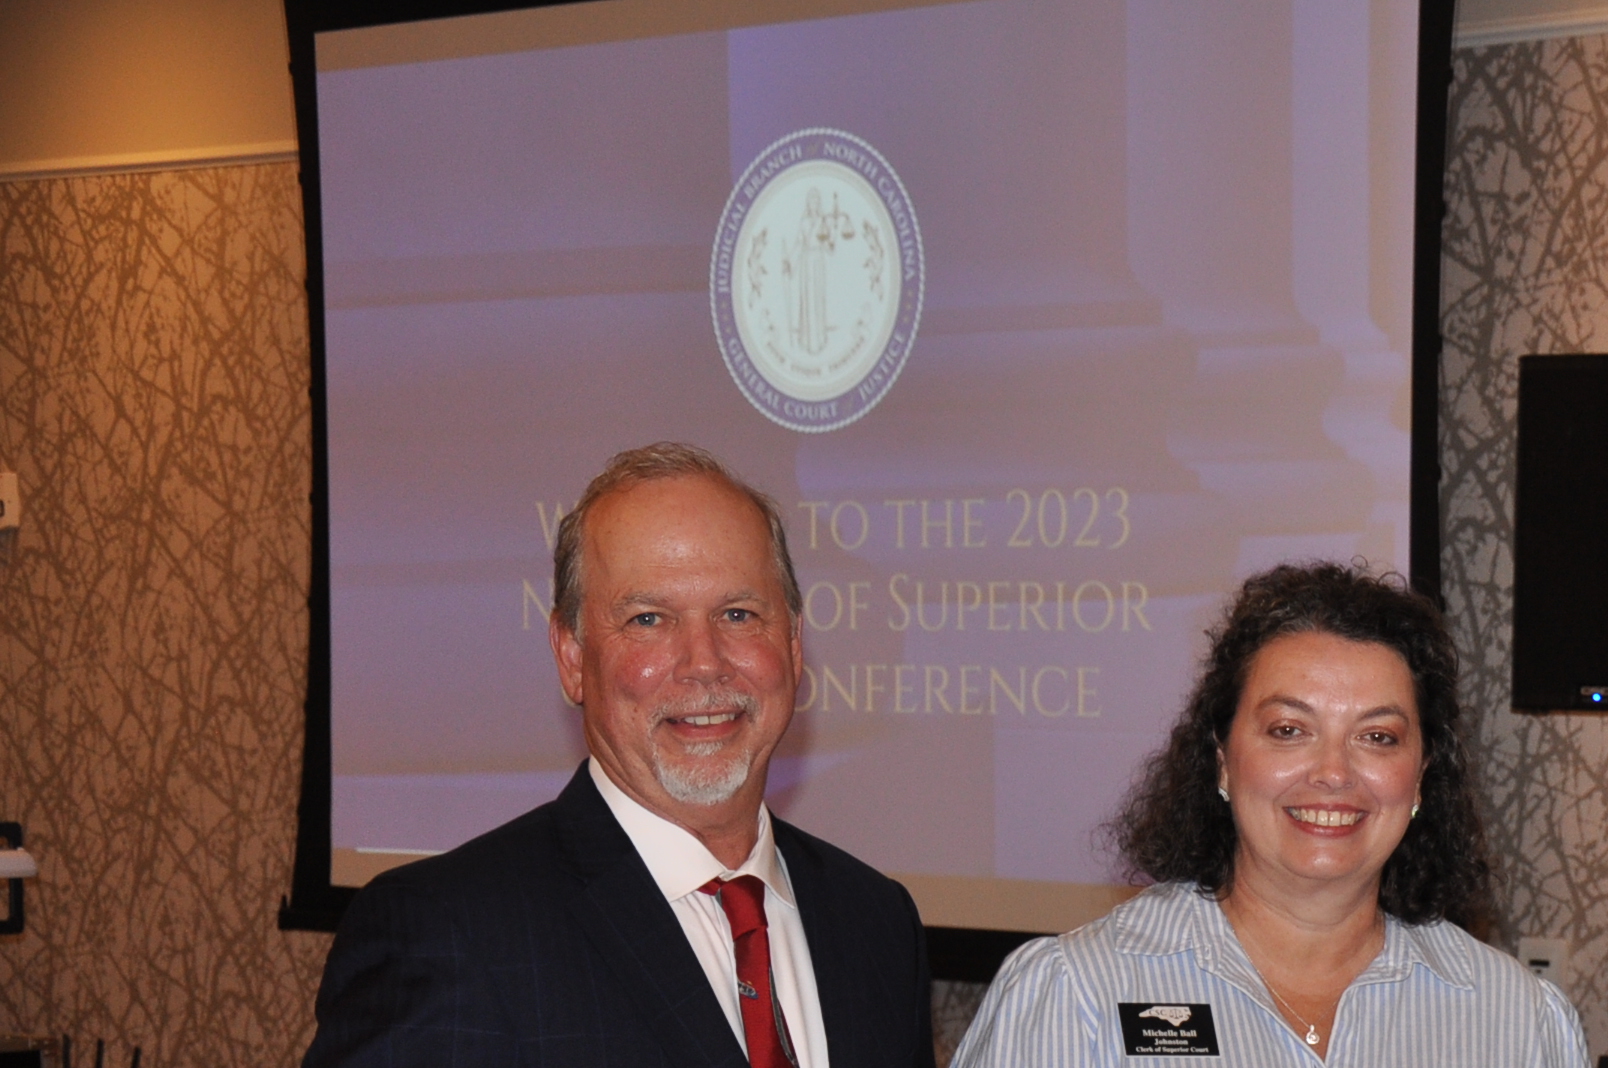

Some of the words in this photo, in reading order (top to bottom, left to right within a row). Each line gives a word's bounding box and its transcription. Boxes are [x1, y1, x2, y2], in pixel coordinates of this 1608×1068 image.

[744, 146, 801, 199] BRANCH
[823, 141, 877, 180] NORTH
[877, 176, 915, 282] CAROLINA
[728, 338, 781, 410] GENERAL
[784, 402, 839, 420] COURT
[798, 500, 869, 550] TO
[884, 500, 988, 549] THE
[1006, 487, 1132, 550] 2023
[803, 581, 870, 631] OF
[795, 666, 1101, 717] ONFERENCE
[1142, 1029, 1178, 1037] Michelle
